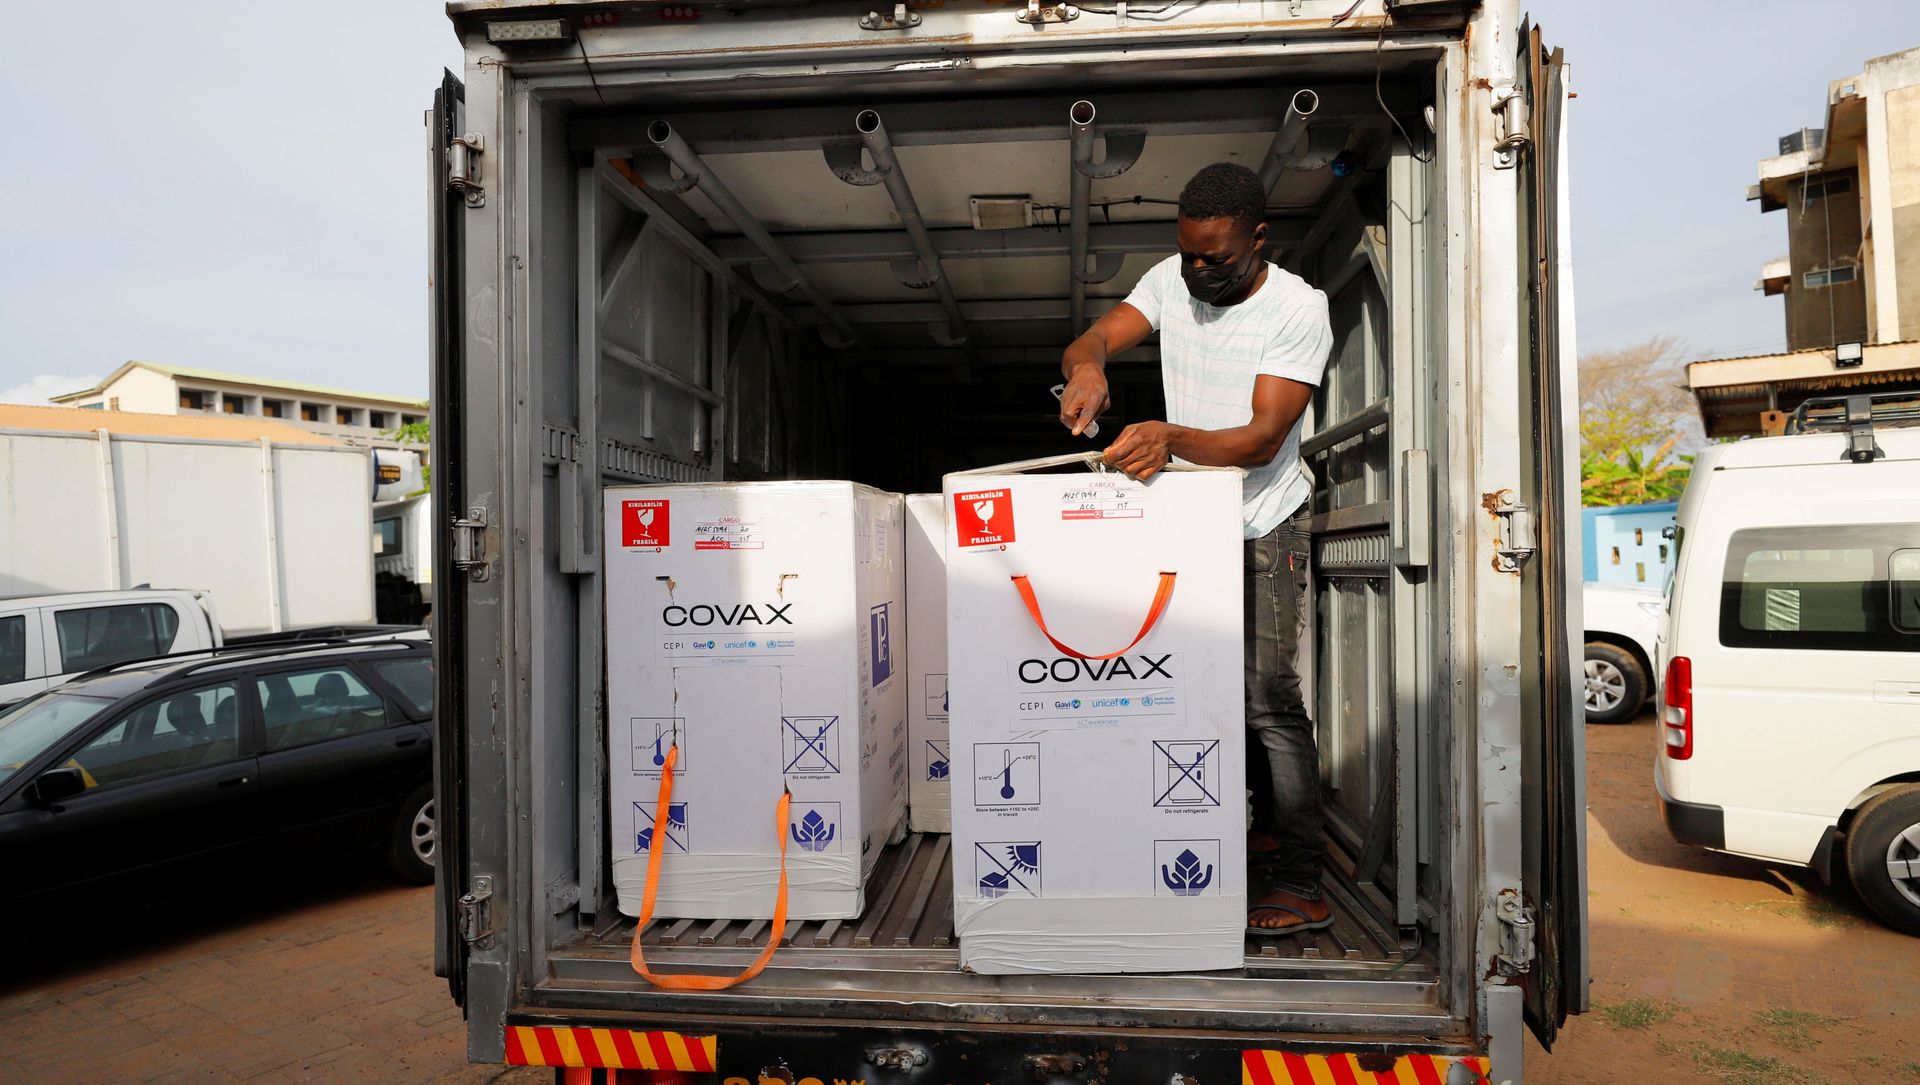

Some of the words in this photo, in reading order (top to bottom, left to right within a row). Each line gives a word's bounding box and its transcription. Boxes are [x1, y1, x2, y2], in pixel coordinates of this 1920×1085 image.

[1115, 490, 1125, 498] 20
[971, 535, 1002, 544] FRAGILE
[663, 604, 793, 626] COVAX
[663, 642, 684, 650] CEPI
[724, 640, 747, 649] unicef
[1018, 654, 1174, 684] COVAX
[1019, 702, 1044, 710] CEPI
[1092, 698, 1119, 708] unicef
